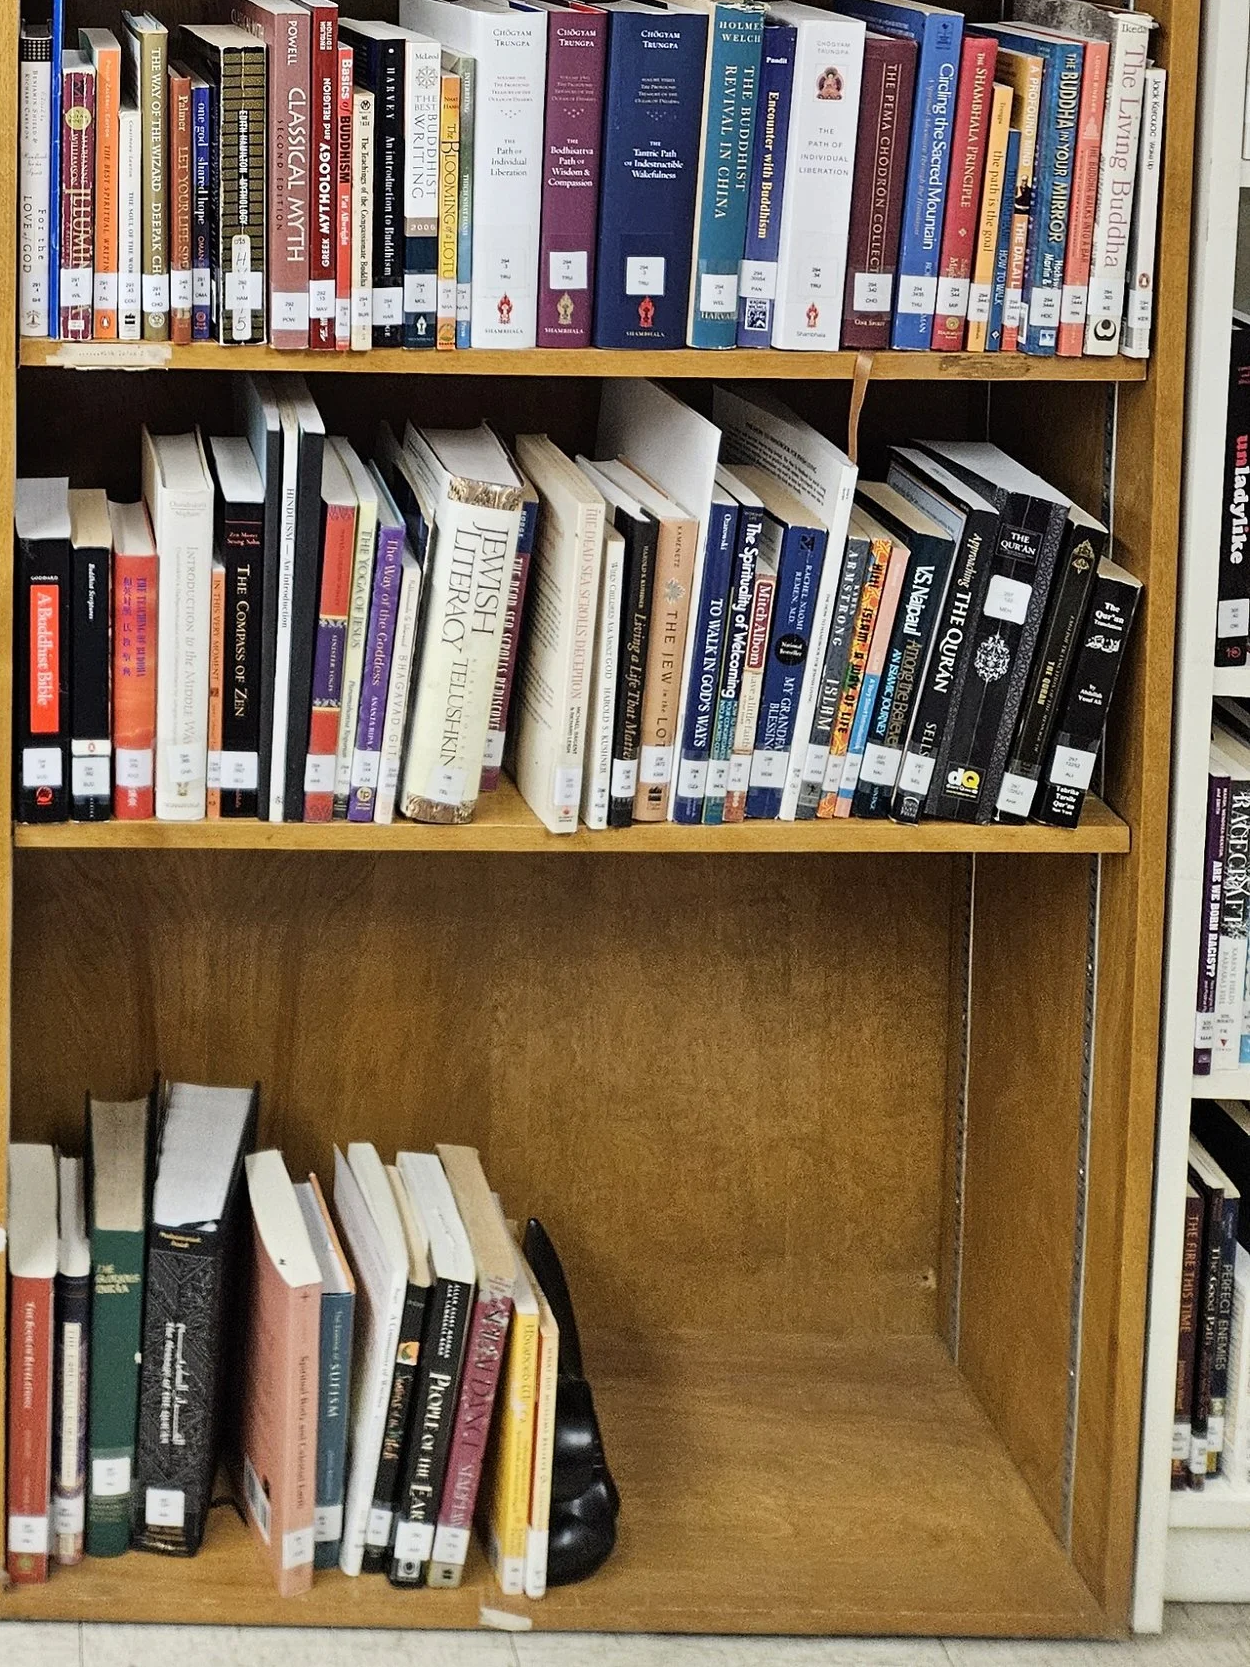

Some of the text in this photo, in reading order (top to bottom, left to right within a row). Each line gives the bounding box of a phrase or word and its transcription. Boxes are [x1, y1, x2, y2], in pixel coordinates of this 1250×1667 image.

[286, 20, 298, 66] POWELL
[642, 40, 679, 49] TRUNGPA
[718, 21, 764, 31] HOLMES
[721, 33, 761, 44] WELCH
[286, 86, 306, 262] CLASSICAL MYTH
[714, 65, 739, 220] REVIVAL IN CHINA
[734, 65, 755, 193] THE BUDDHIST
[757, 91, 780, 239] Encounter with Buddhism
[1103, 45, 1148, 269] The Living Buddha
[1230, 435, 1250, 564] unladylike
[440, 527, 478, 654] LITERACY
[471, 521, 508, 636] JEWISH
[950, 591, 972, 626] THE
[956, 532, 983, 589] Approaching
[234, 564, 251, 717] THE COMPASS OF ZEN
[750, 584, 771, 666] Mitch Albom
[423, 1371, 450, 1432] PEOPLE
